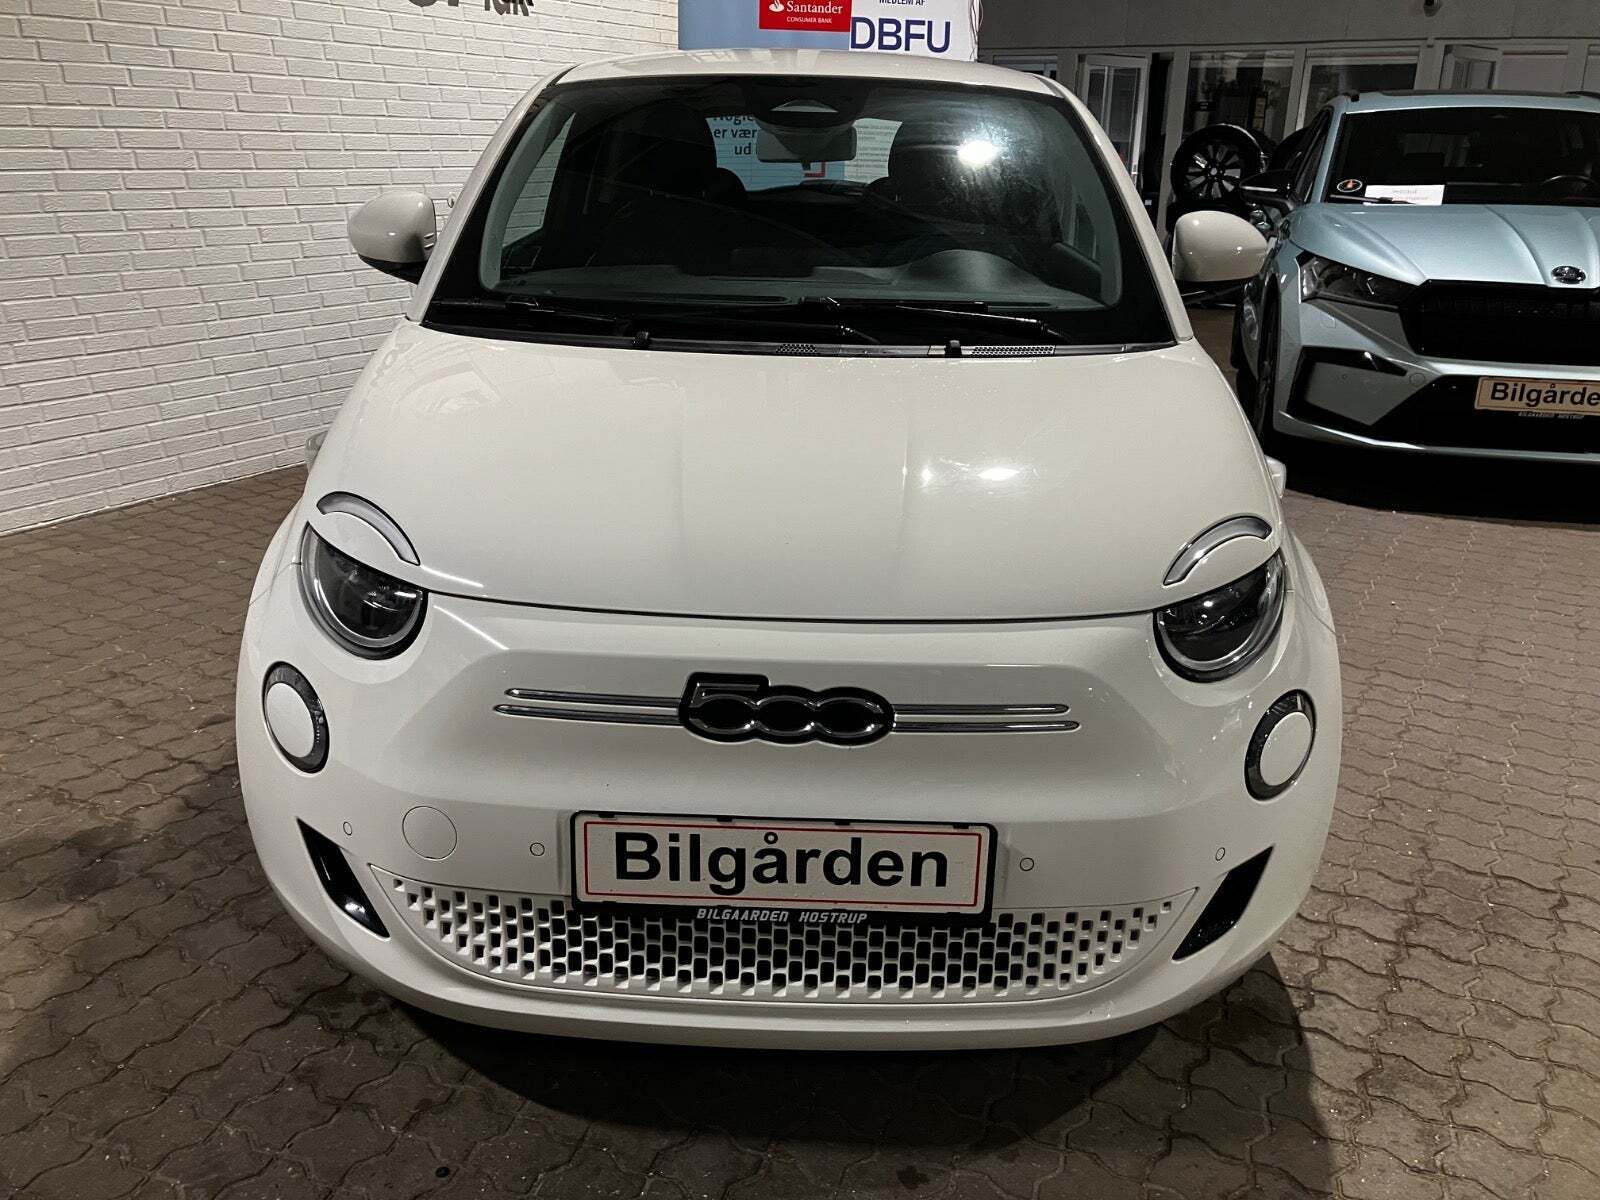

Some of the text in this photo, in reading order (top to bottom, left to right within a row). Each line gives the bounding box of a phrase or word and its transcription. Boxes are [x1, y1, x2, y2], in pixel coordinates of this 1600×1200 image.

[786, 0, 843, 14] Santander
[786, 16, 817, 24] CONSUMER
[851, 17, 951, 53] DBFU
[713, 128, 727, 138] er
[734, 142, 752, 155] ud
[1490, 382, 1600, 407] Bilgårde
[614, 830, 949, 896] Bilgården
[697, 908, 868, 925] BILGAARDEN HOSTRUP
